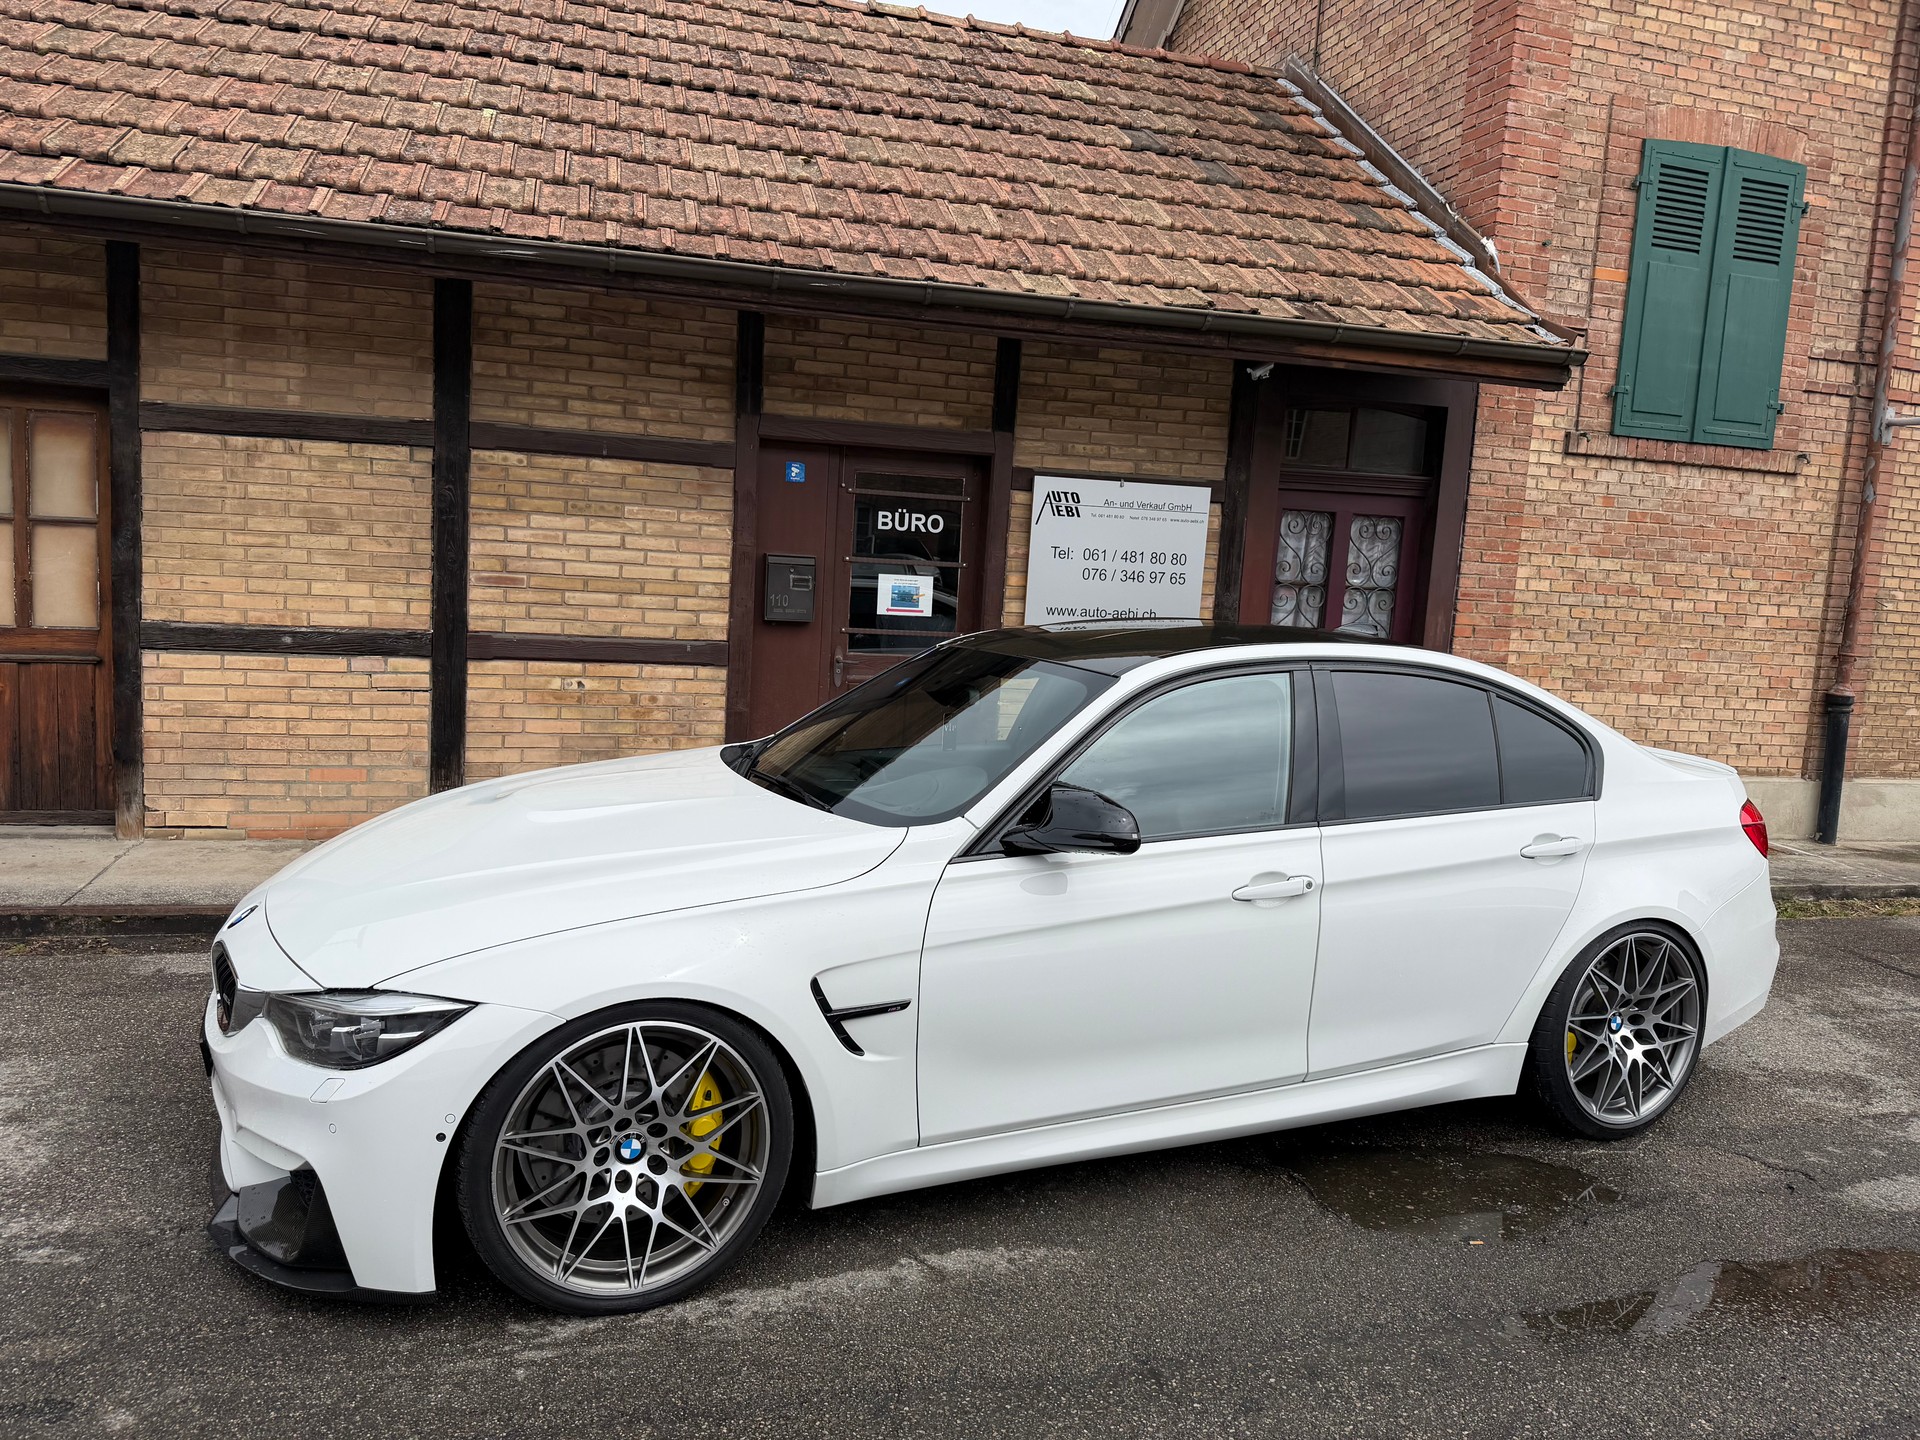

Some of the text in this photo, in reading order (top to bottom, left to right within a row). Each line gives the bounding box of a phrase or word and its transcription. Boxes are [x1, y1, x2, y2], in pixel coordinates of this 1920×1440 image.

[1103, 498, 1193, 511] An- und Verkauf GmbH
[877, 508, 944, 534] BÜRO
[1050, 546, 1187, 566] Tel: 061 / 481 80 80
[1082, 567, 1186, 586] 076 / 346 97 65
[770, 594, 788, 607] 110
[1046, 606, 1156, 618] www.auto-aebich
